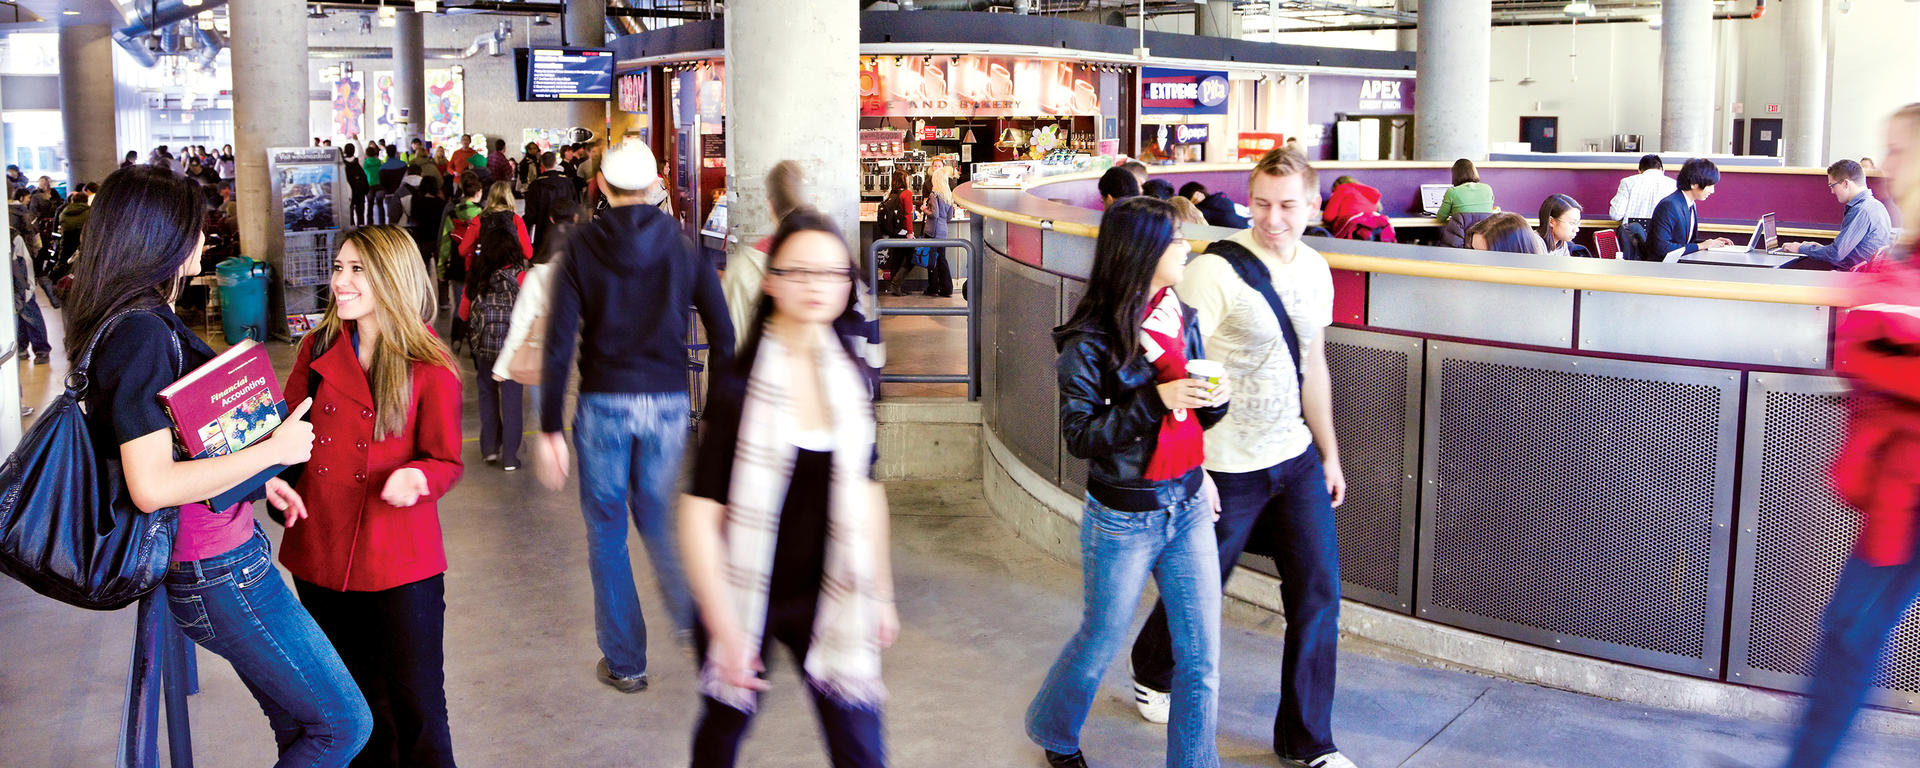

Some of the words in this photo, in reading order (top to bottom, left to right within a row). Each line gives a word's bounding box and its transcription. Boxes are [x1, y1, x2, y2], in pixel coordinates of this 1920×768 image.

[1150, 83, 1198, 99] EXTREME
[1359, 80, 1401, 99] APEX
[908, 100, 948, 109] AND
[959, 100, 1022, 109] BAKERY
[1768, 104, 1778, 112] EXIT
[1187, 127, 1207, 139] pepsi
[211, 376, 248, 404] Financial
[222, 376, 266, 407] Accounting
